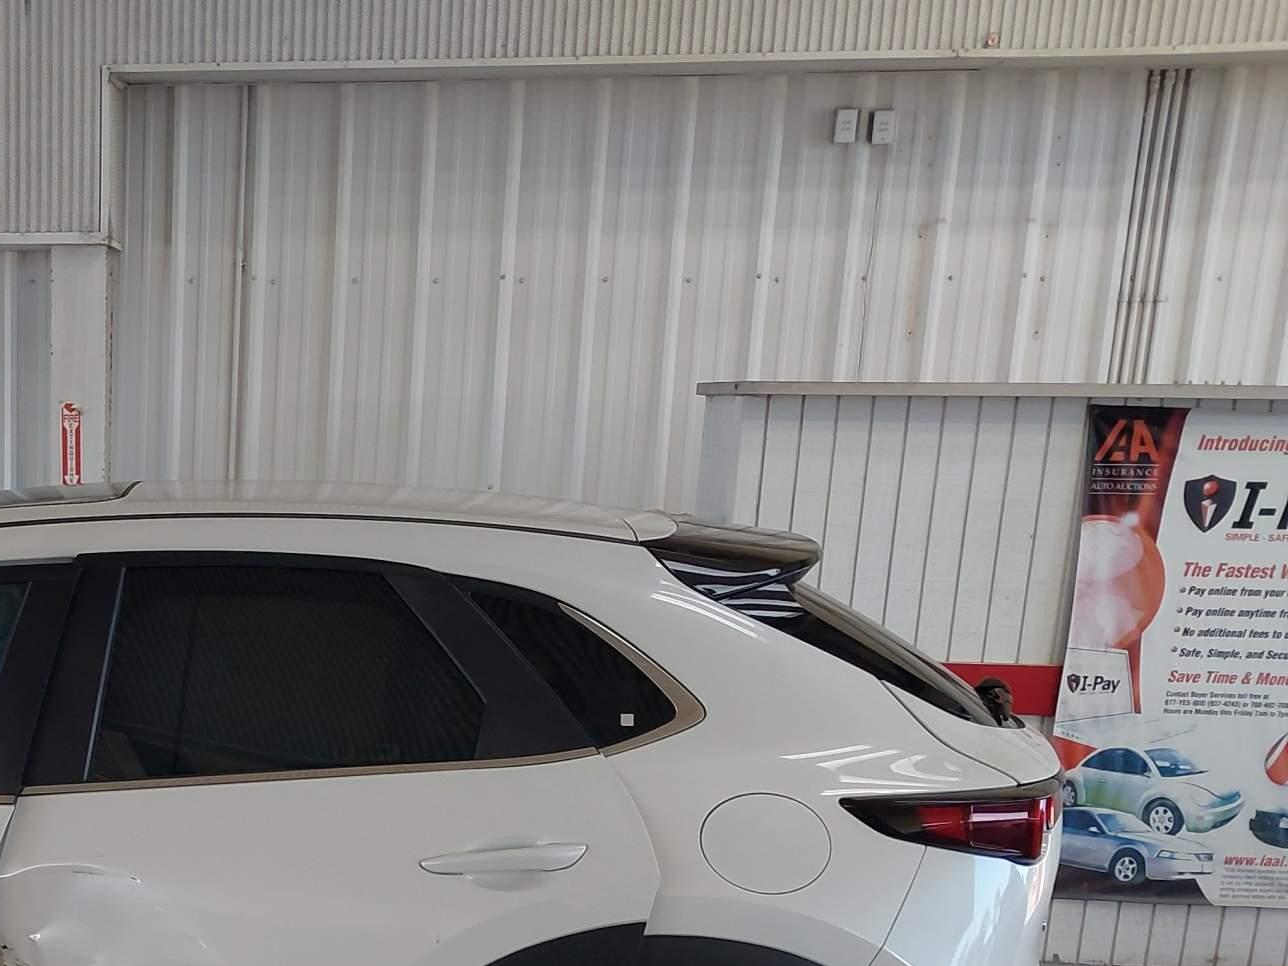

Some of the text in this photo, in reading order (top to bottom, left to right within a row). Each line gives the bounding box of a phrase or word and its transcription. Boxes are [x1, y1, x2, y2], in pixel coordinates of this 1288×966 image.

[1092, 468, 1159, 477] INSURANCE
[1115, 483, 1158, 491] AUCTIONS
[1225, 533, 1260, 542] SIMPLE
[1183, 562, 1212, 578] The
[1216, 563, 1277, 579] Fastest
[1188, 586, 1286, 600] Pay online from your
[1185, 607, 1203, 619] Pay
[1206, 608, 1237, 618] online
[1238, 608, 1278, 620] anytime
[1182, 627, 1195, 637] No
[1197, 628, 1248, 638] additional
[1249, 629, 1270, 639] fees
[1273, 630, 1283, 640] to
[1179, 648, 1204, 659] Safe,
[1207, 648, 1243, 660] Simple,
[1246, 650, 1266, 659] and
[1168, 670, 1201, 684] Save
[1205, 671, 1238, 685] Time
[1241, 671, 1253, 685] &
[1080, 676, 1121, 694] I-Pay
[1224, 854, 1288, 867] www.iaai.
